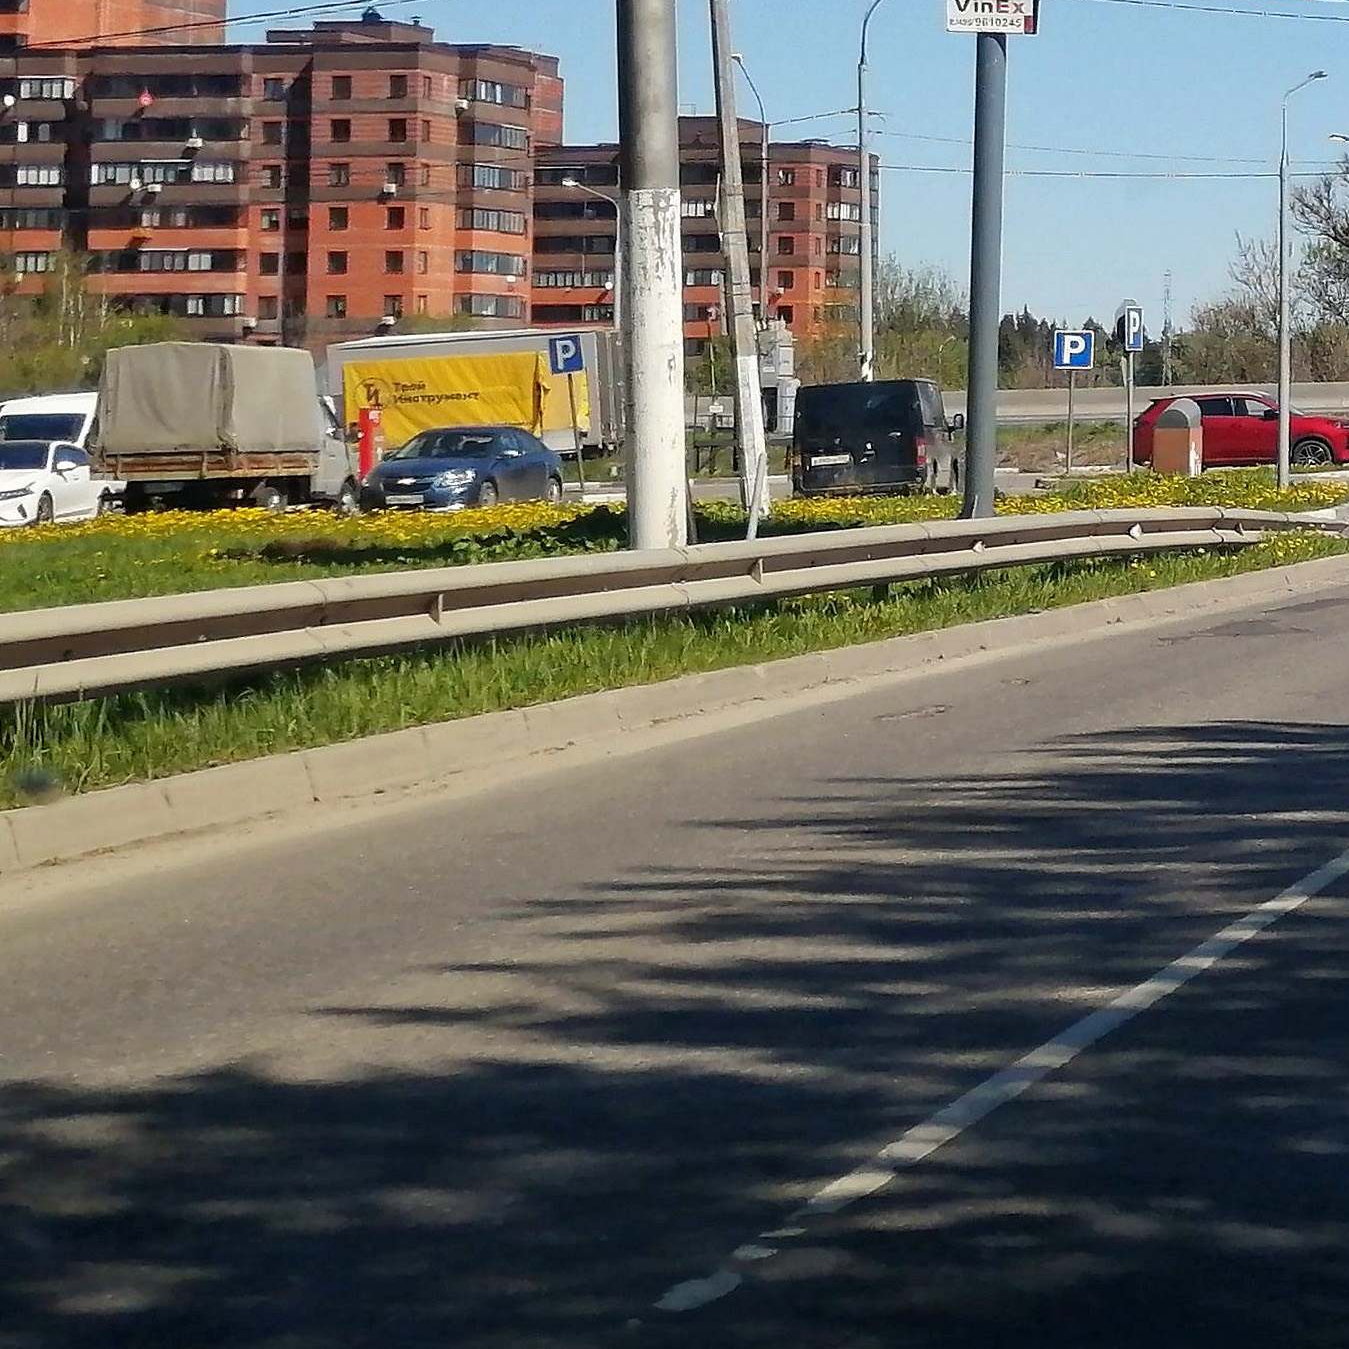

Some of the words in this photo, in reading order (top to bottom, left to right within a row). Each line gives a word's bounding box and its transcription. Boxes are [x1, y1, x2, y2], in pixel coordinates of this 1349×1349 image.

[1129, 310, 1140, 345] P
[555, 339, 576, 371] P
[1062, 334, 1086, 365] P
